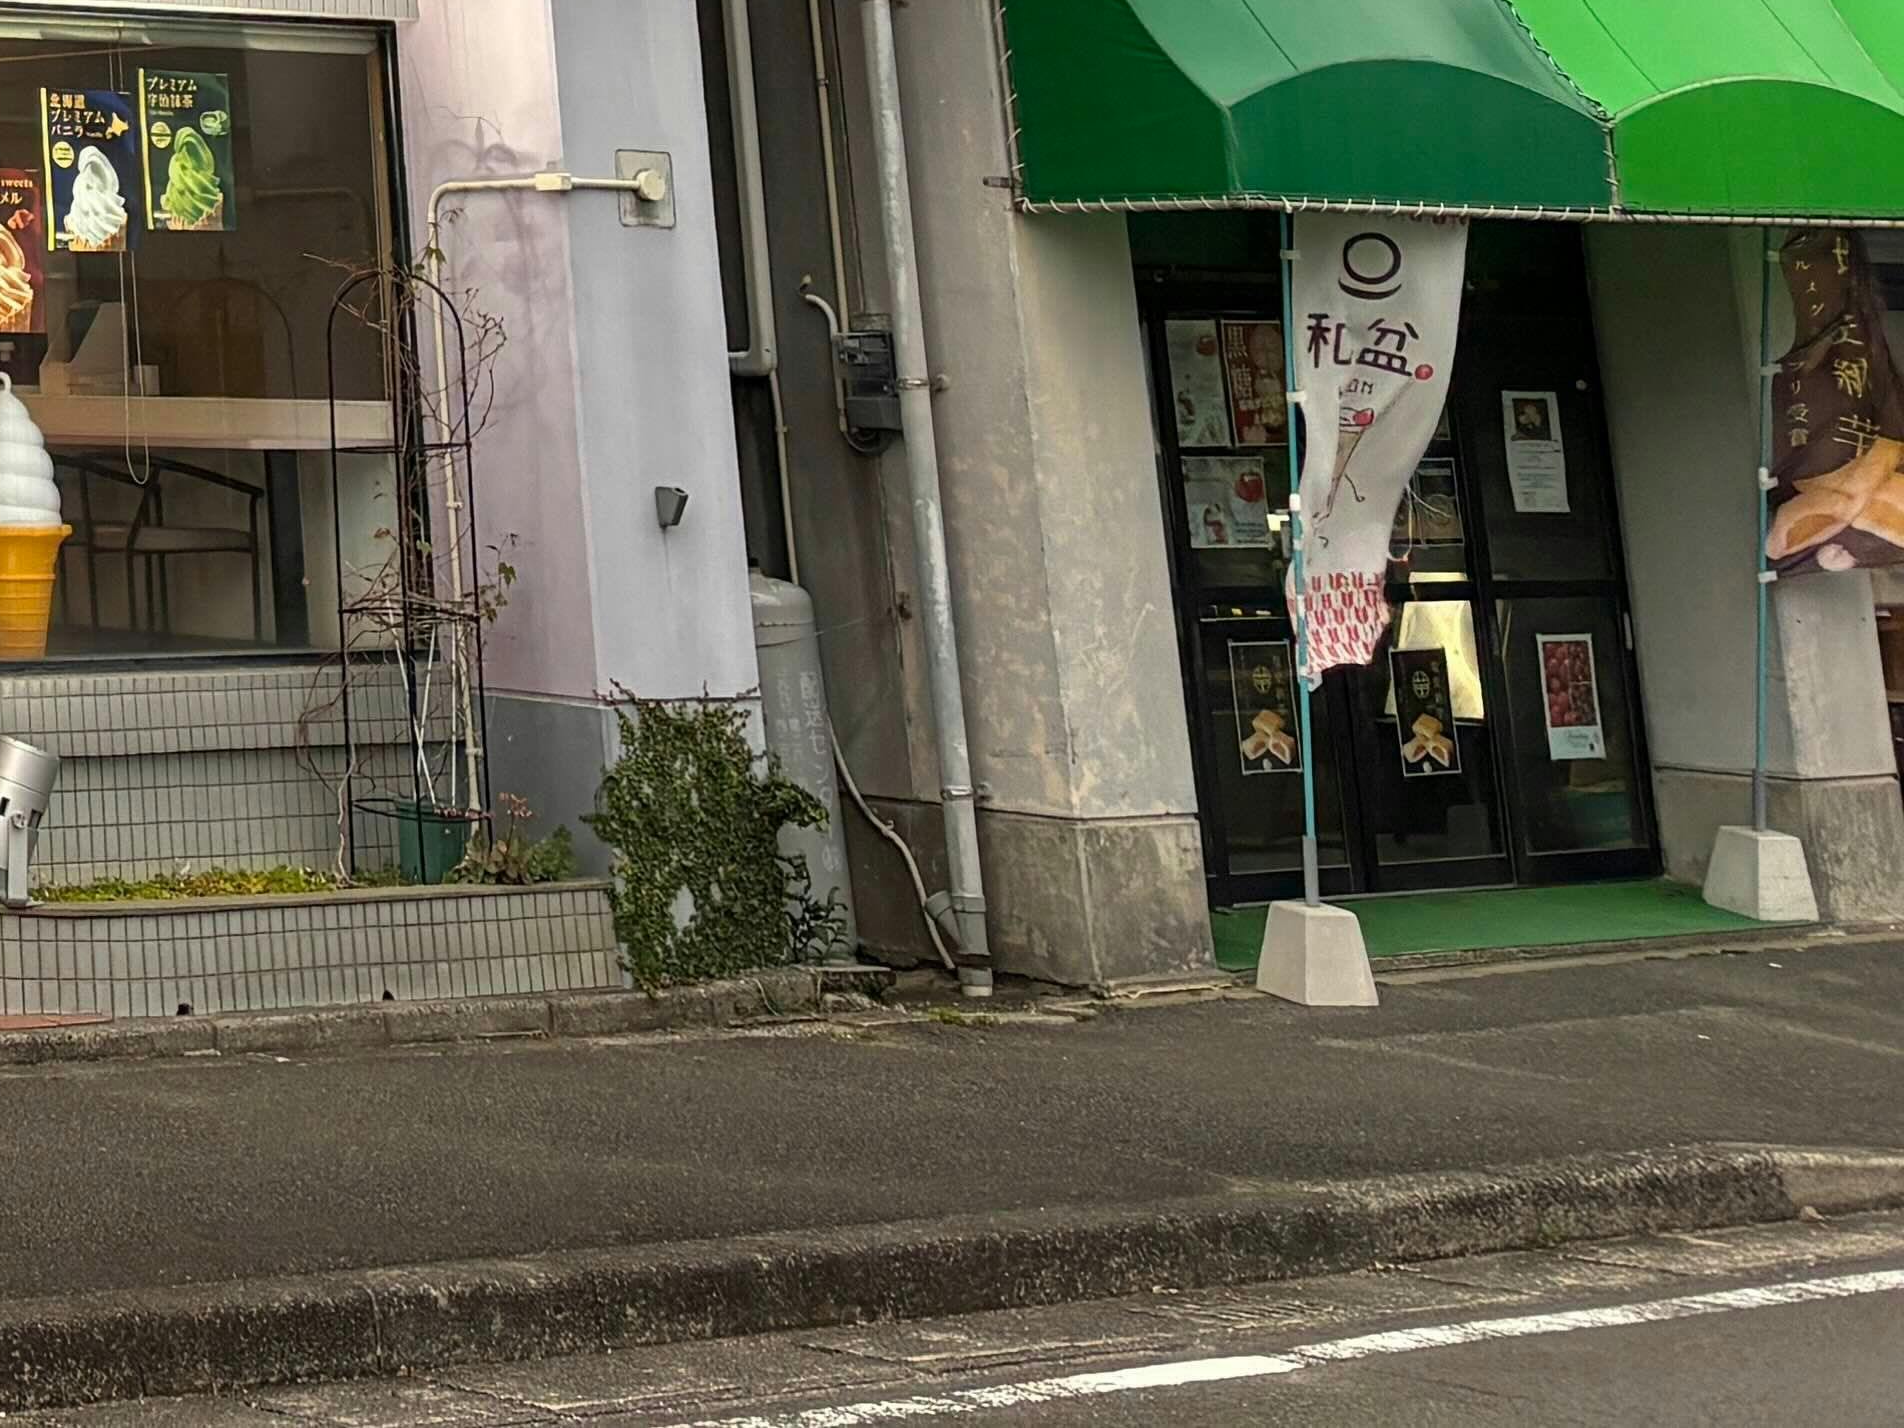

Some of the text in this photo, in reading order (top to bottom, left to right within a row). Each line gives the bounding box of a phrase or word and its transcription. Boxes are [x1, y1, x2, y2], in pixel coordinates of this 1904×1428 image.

[147, 76, 197, 91] プレミアム
[50, 110, 105, 123] プレミアム
